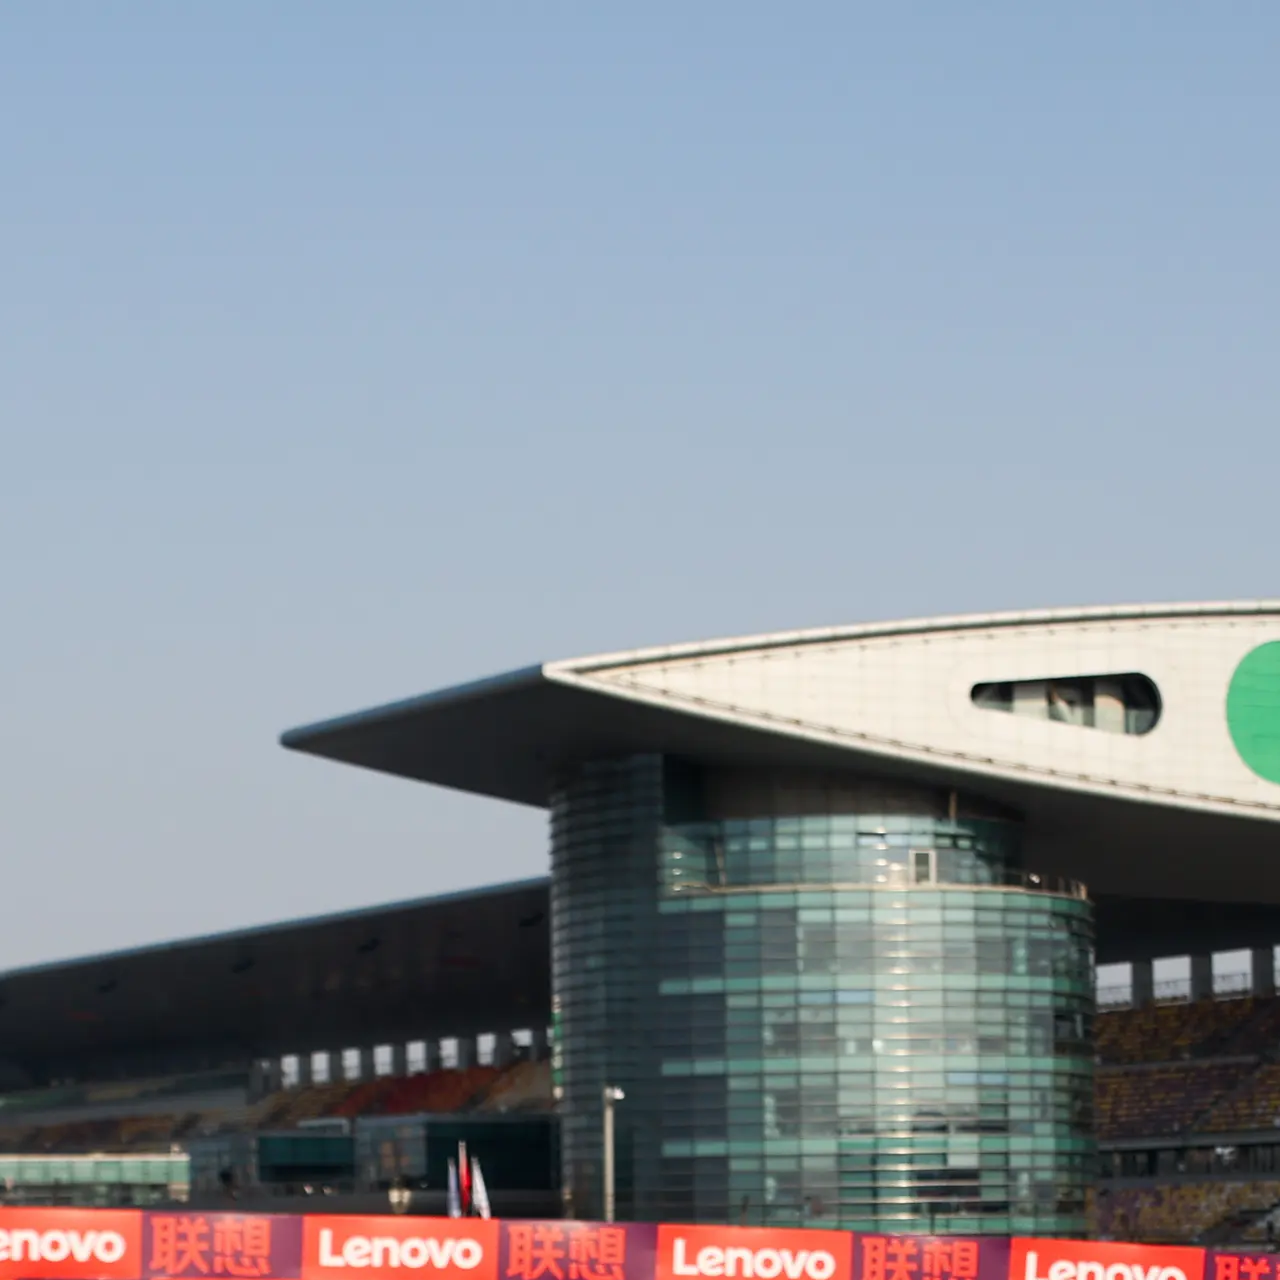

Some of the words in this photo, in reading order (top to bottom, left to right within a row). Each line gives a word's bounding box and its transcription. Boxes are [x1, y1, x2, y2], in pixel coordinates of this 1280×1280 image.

[150, 1215, 272, 1278] 联想
[318, 1227, 484, 1270] Lenovo
[672, 1237, 837, 1280] Lenovo
